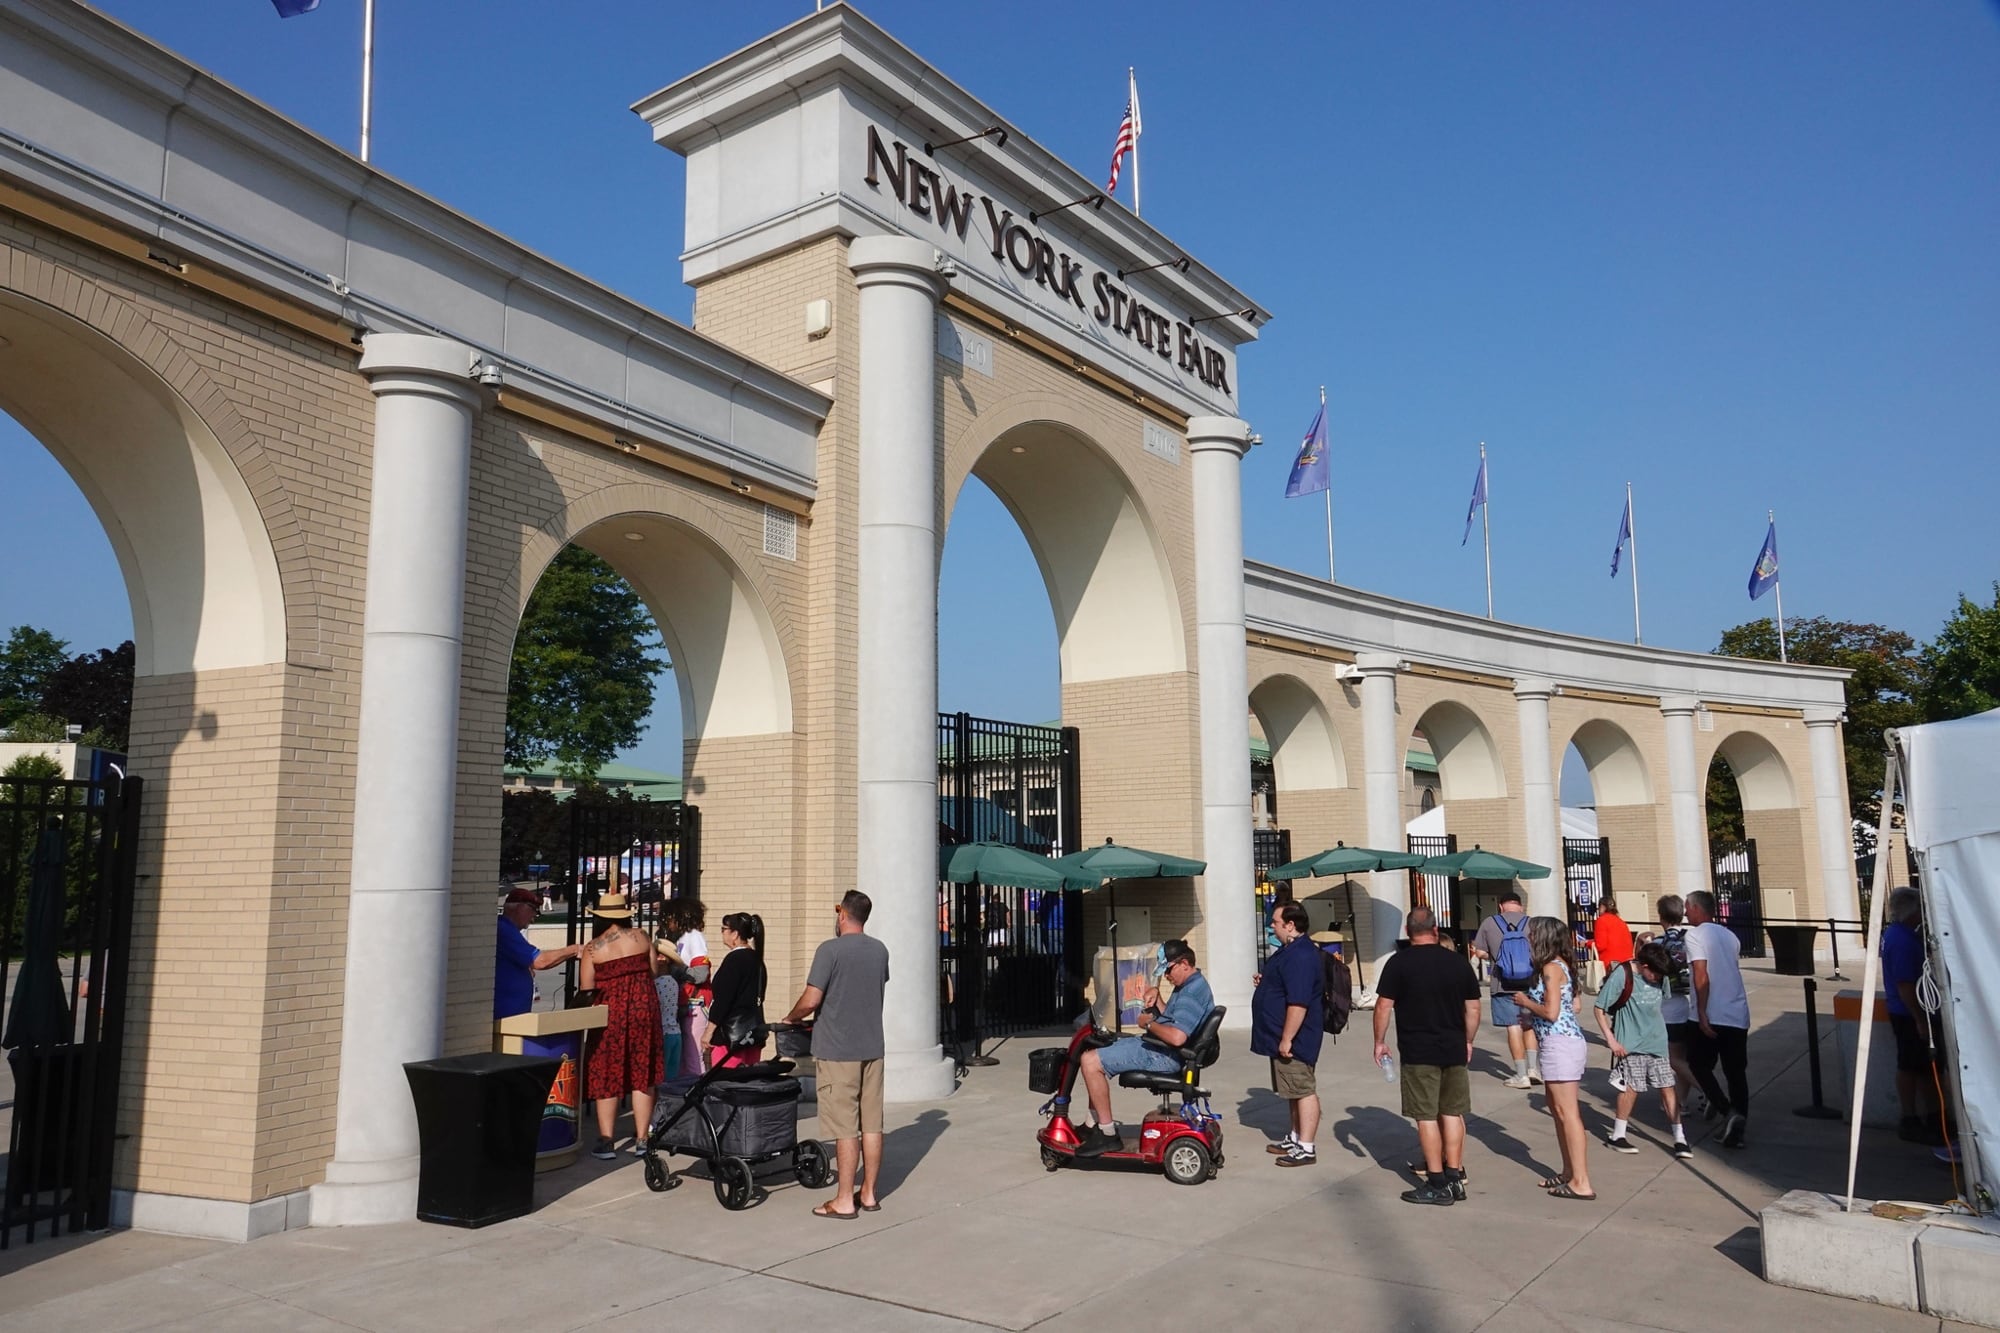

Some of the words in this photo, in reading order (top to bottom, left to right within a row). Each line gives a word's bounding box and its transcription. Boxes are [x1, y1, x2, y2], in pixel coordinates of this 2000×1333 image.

[864, 125, 974, 237] NEW
[980, 196, 1086, 309] YORK
[1093, 271, 1172, 358] STATE
[1176, 322, 1232, 395] FAIR
